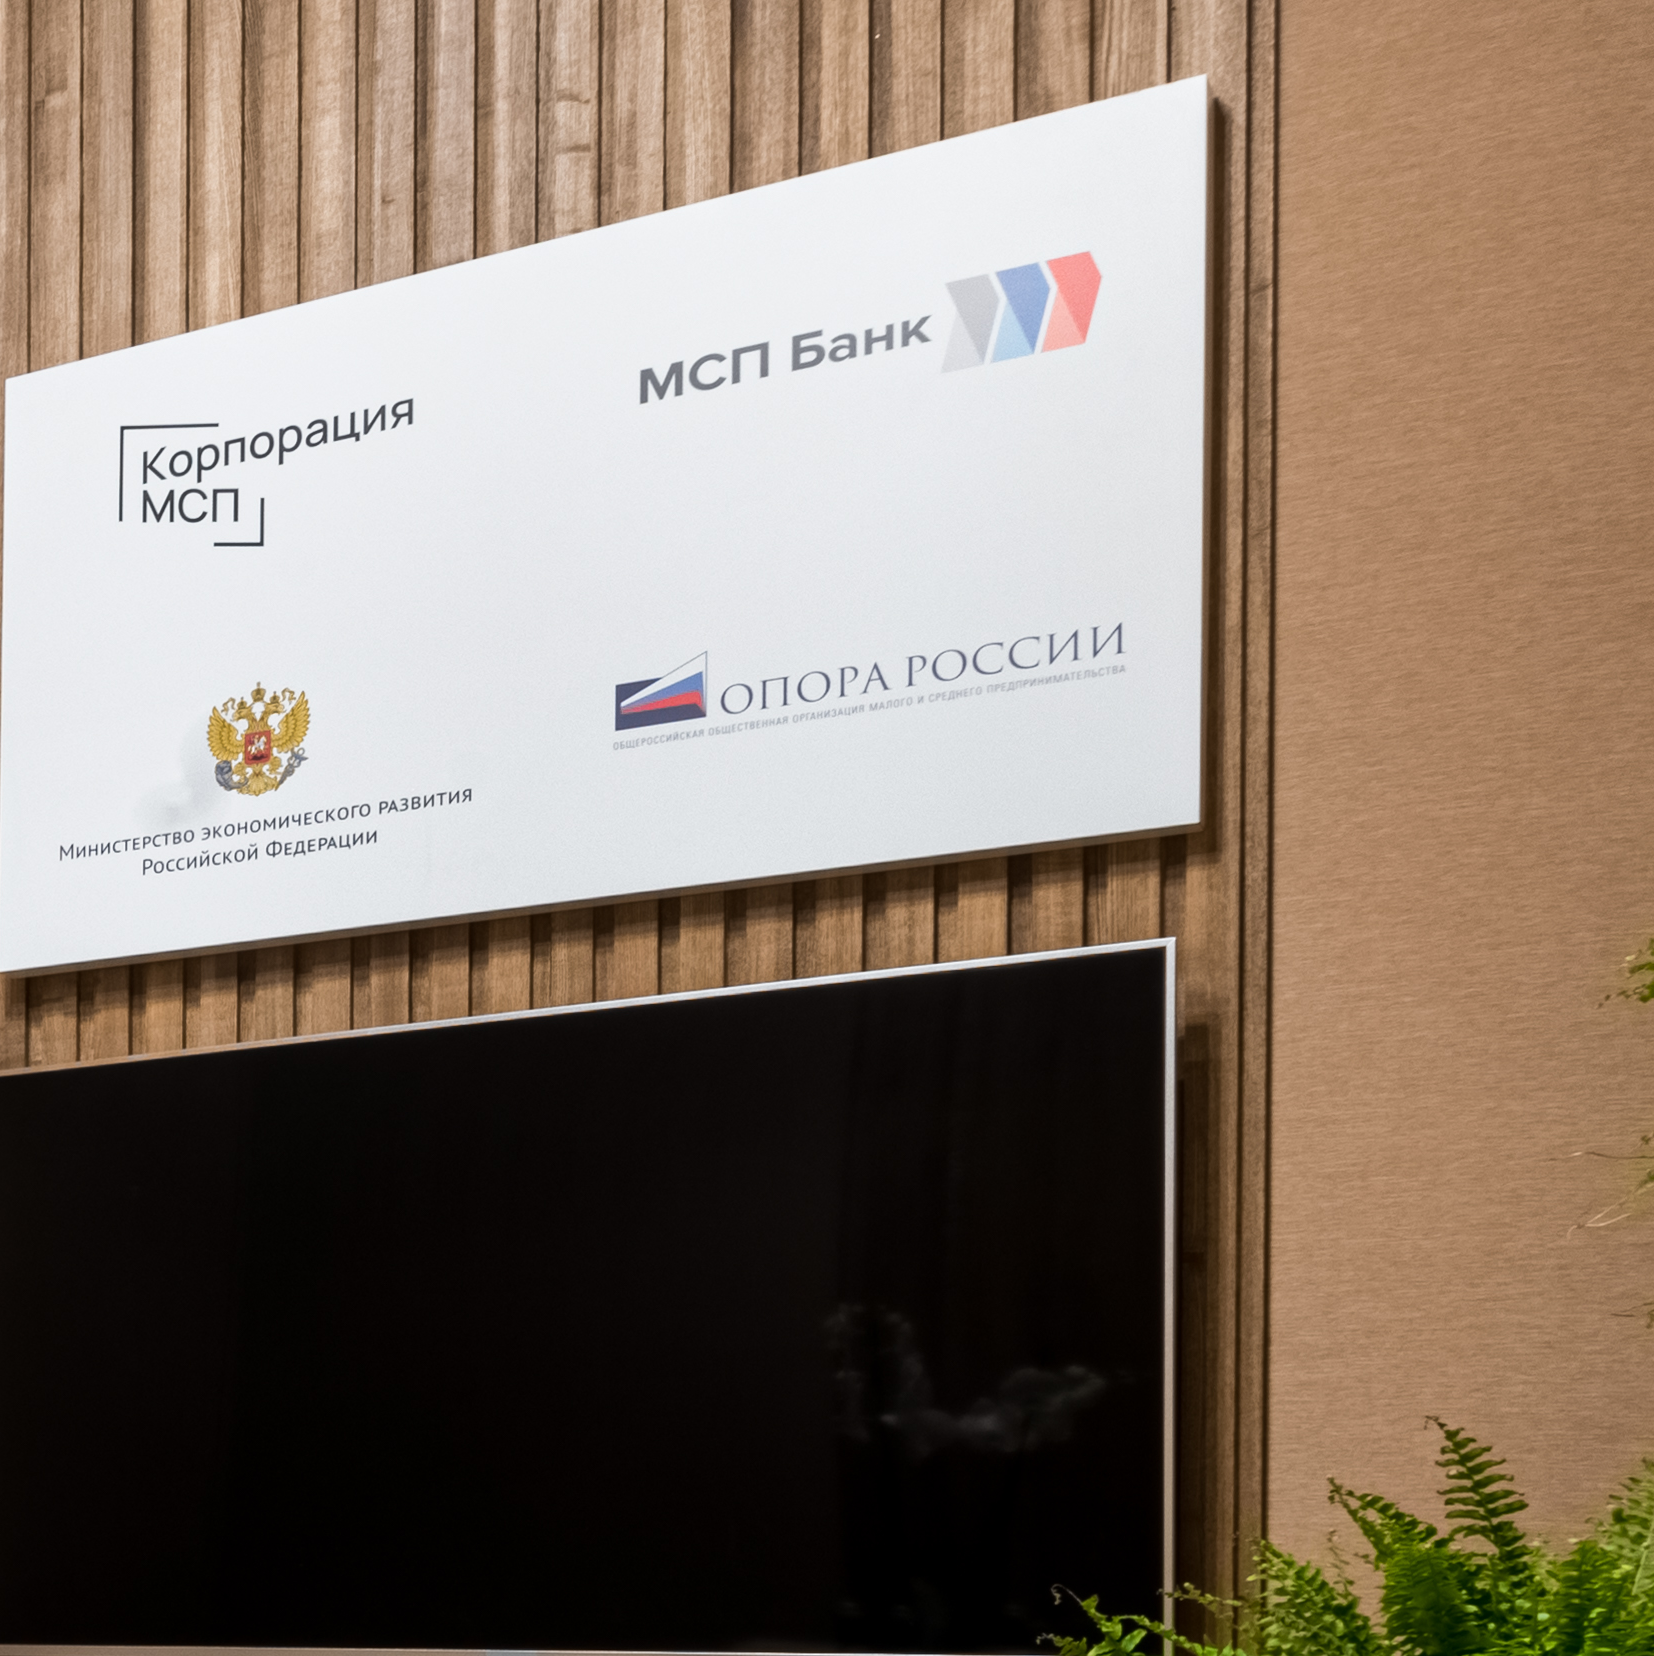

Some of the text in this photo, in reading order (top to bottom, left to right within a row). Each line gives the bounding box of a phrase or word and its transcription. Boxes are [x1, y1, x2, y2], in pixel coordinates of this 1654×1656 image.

[639, 314, 932, 405] МСП Банк
[142, 397, 414, 485] Корпорация
[142, 487, 240, 523] МСП
[612, 664, 1126, 750] ОБЩЕРОССИЙСКАЯ ОБЩЕСТВЕННАЯ ОРГАНИЗАЦИЯ МАЛОГО И СРЕДНЕГО ПРЕДПРИНИМАТЕЛЬСТВА
[719, 622, 1126, 715] ОПОРА РОССИИ
